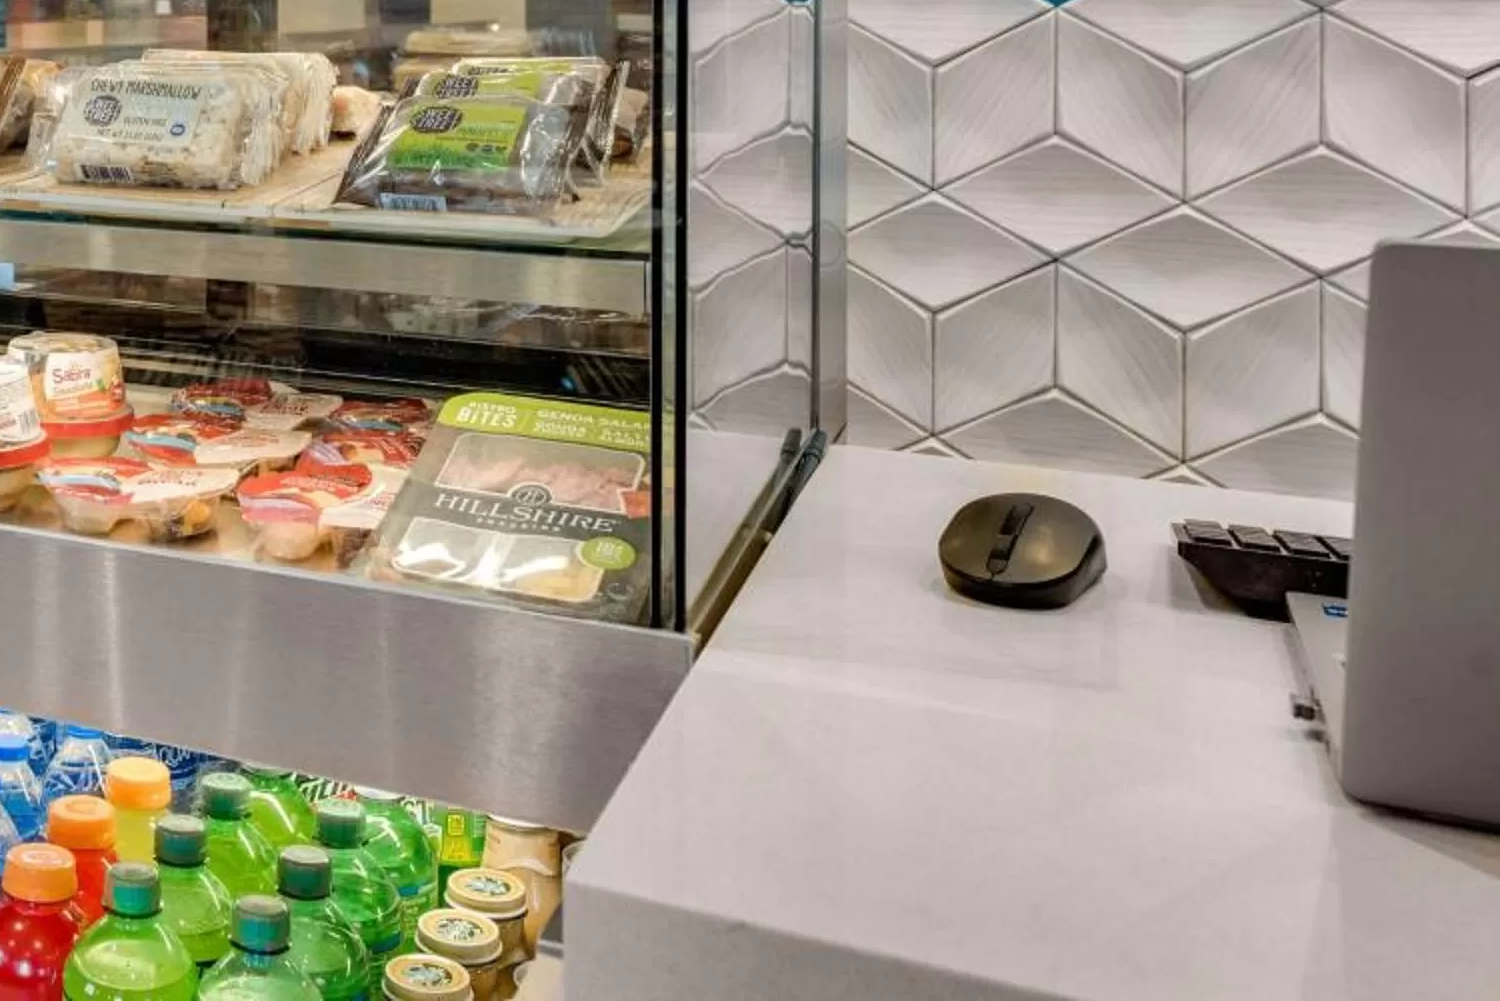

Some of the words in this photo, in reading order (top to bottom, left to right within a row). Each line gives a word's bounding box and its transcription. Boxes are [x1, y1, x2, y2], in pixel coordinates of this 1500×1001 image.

[91, 78, 124, 93] CHEWY
[125, 80, 202, 100] MARSHMALLOW
[455, 407, 518, 428] BITES
[535, 408, 594, 424] GENOA
[434, 492, 617, 533] HILLSHIRE
